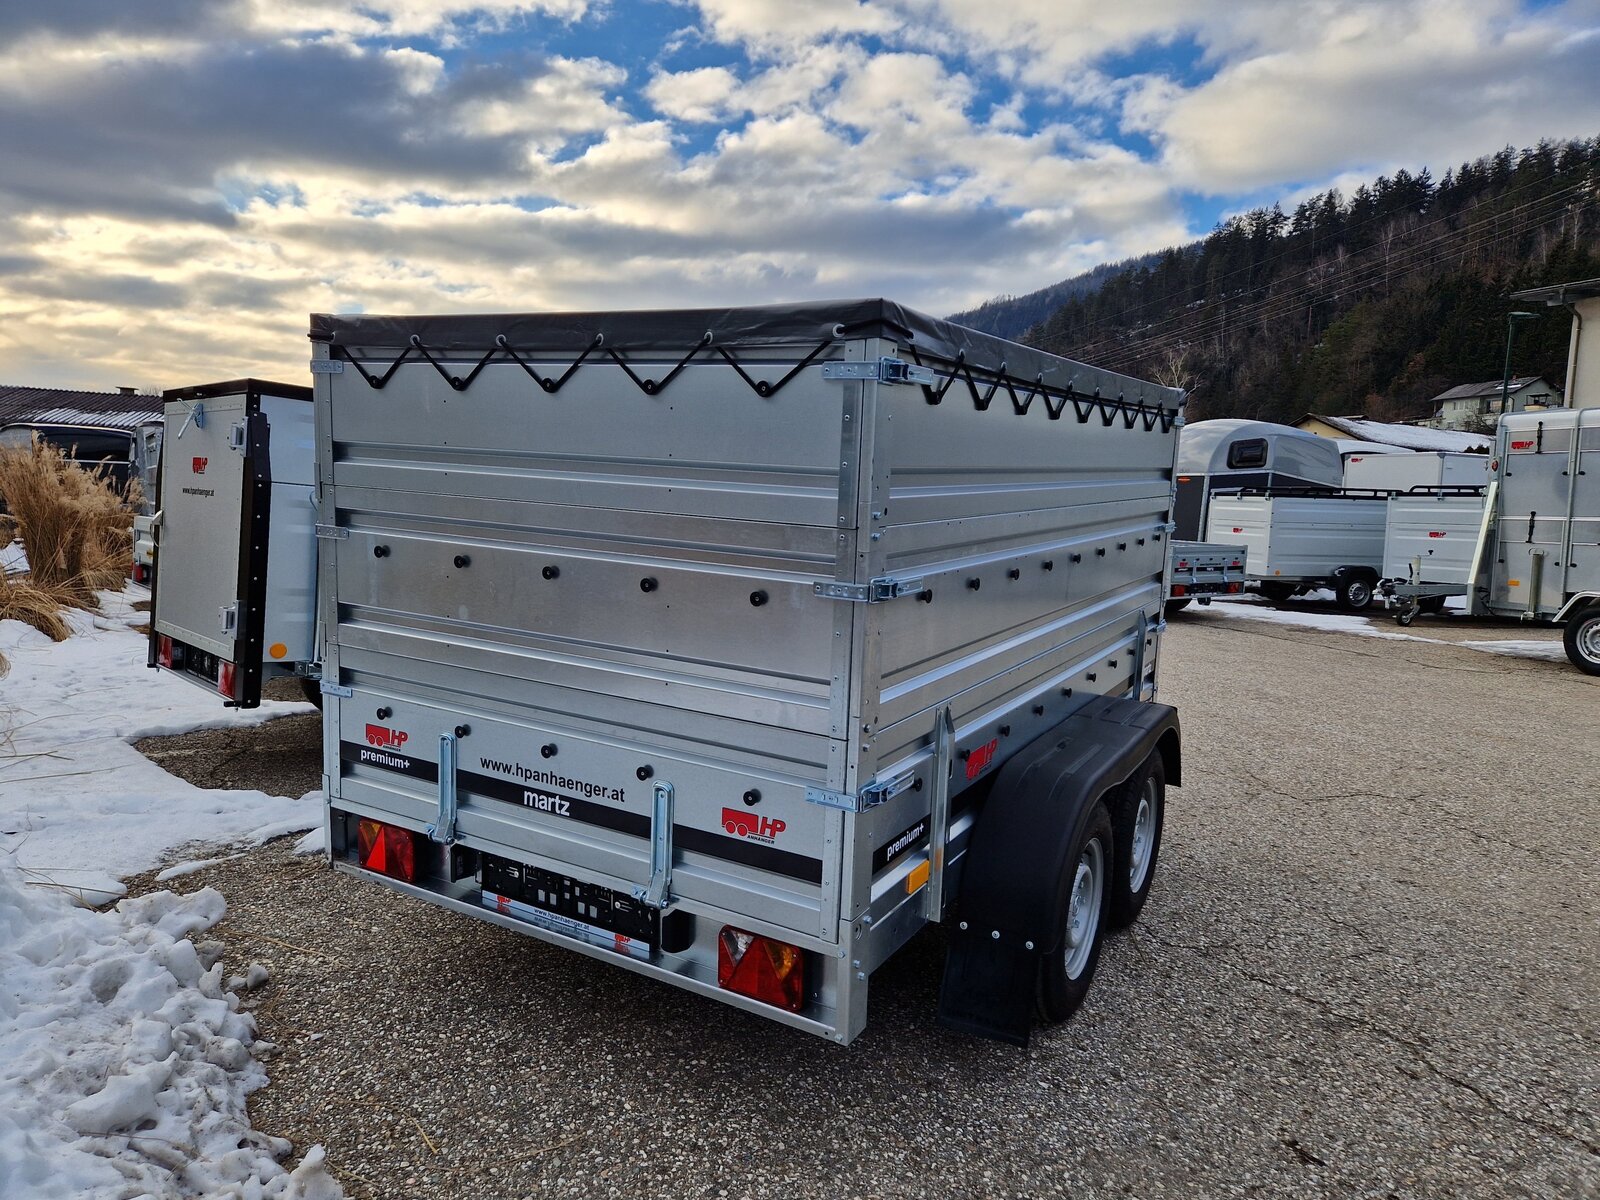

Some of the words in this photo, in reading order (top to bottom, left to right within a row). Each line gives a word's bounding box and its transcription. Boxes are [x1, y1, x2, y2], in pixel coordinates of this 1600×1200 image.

[391, 729, 408, 747] HP
[360, 750, 410, 769] premium+
[480, 757, 625, 802] www.hpanhaenger.at
[523, 790, 570, 816] martz
[760, 815, 787, 838] HP
[887, 822, 924, 861] premium+
